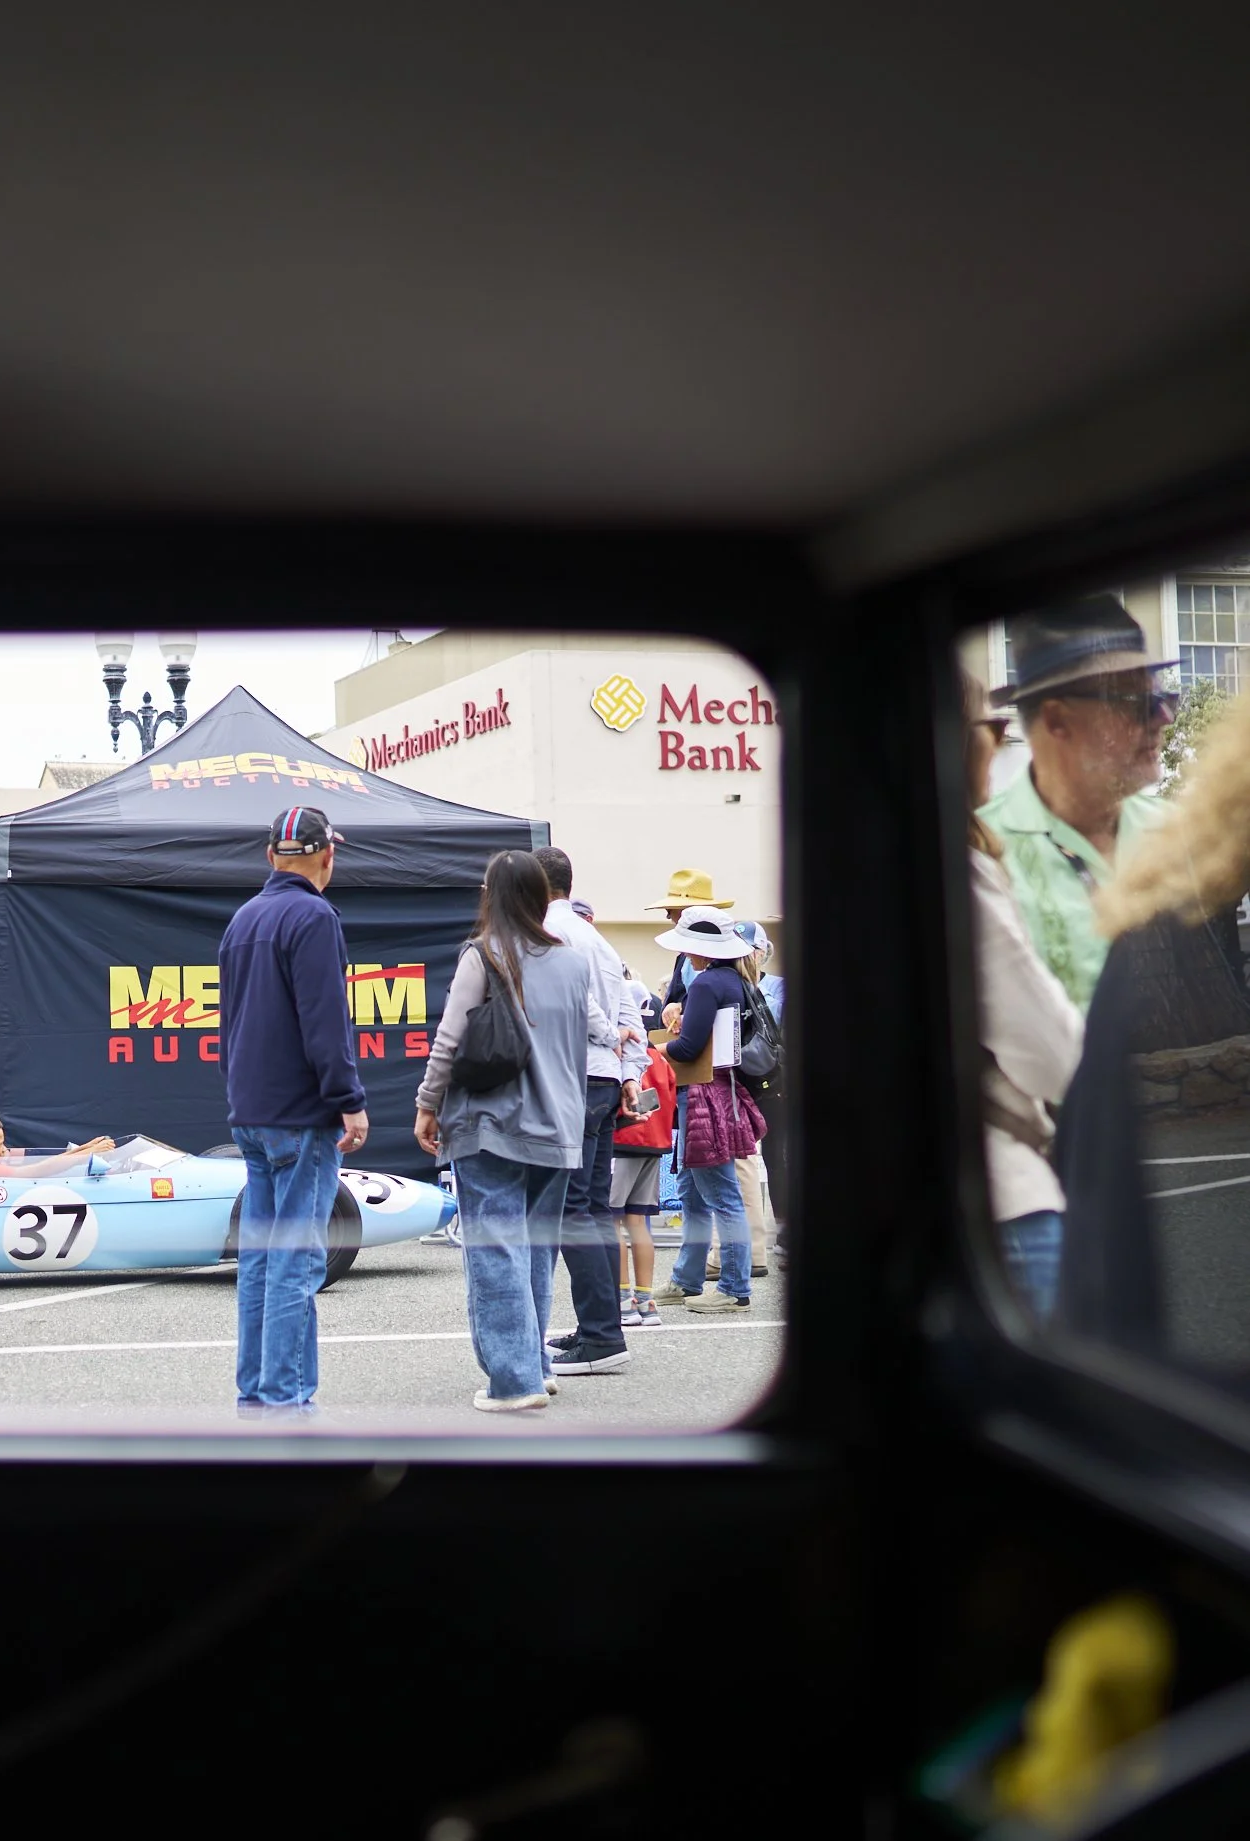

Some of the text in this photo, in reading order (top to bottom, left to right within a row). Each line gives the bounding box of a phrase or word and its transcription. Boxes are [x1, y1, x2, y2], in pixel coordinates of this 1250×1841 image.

[371, 688, 511, 772] Mechanics Bank
[150, 752, 364, 787] MECUM
[658, 731, 762, 771] Bank
[152, 773, 369, 793] AUCTIONS
[109, 963, 427, 1029] MEM
[108, 1031, 430, 1062] AUCNS
[8, 1204, 88, 1261] 37
